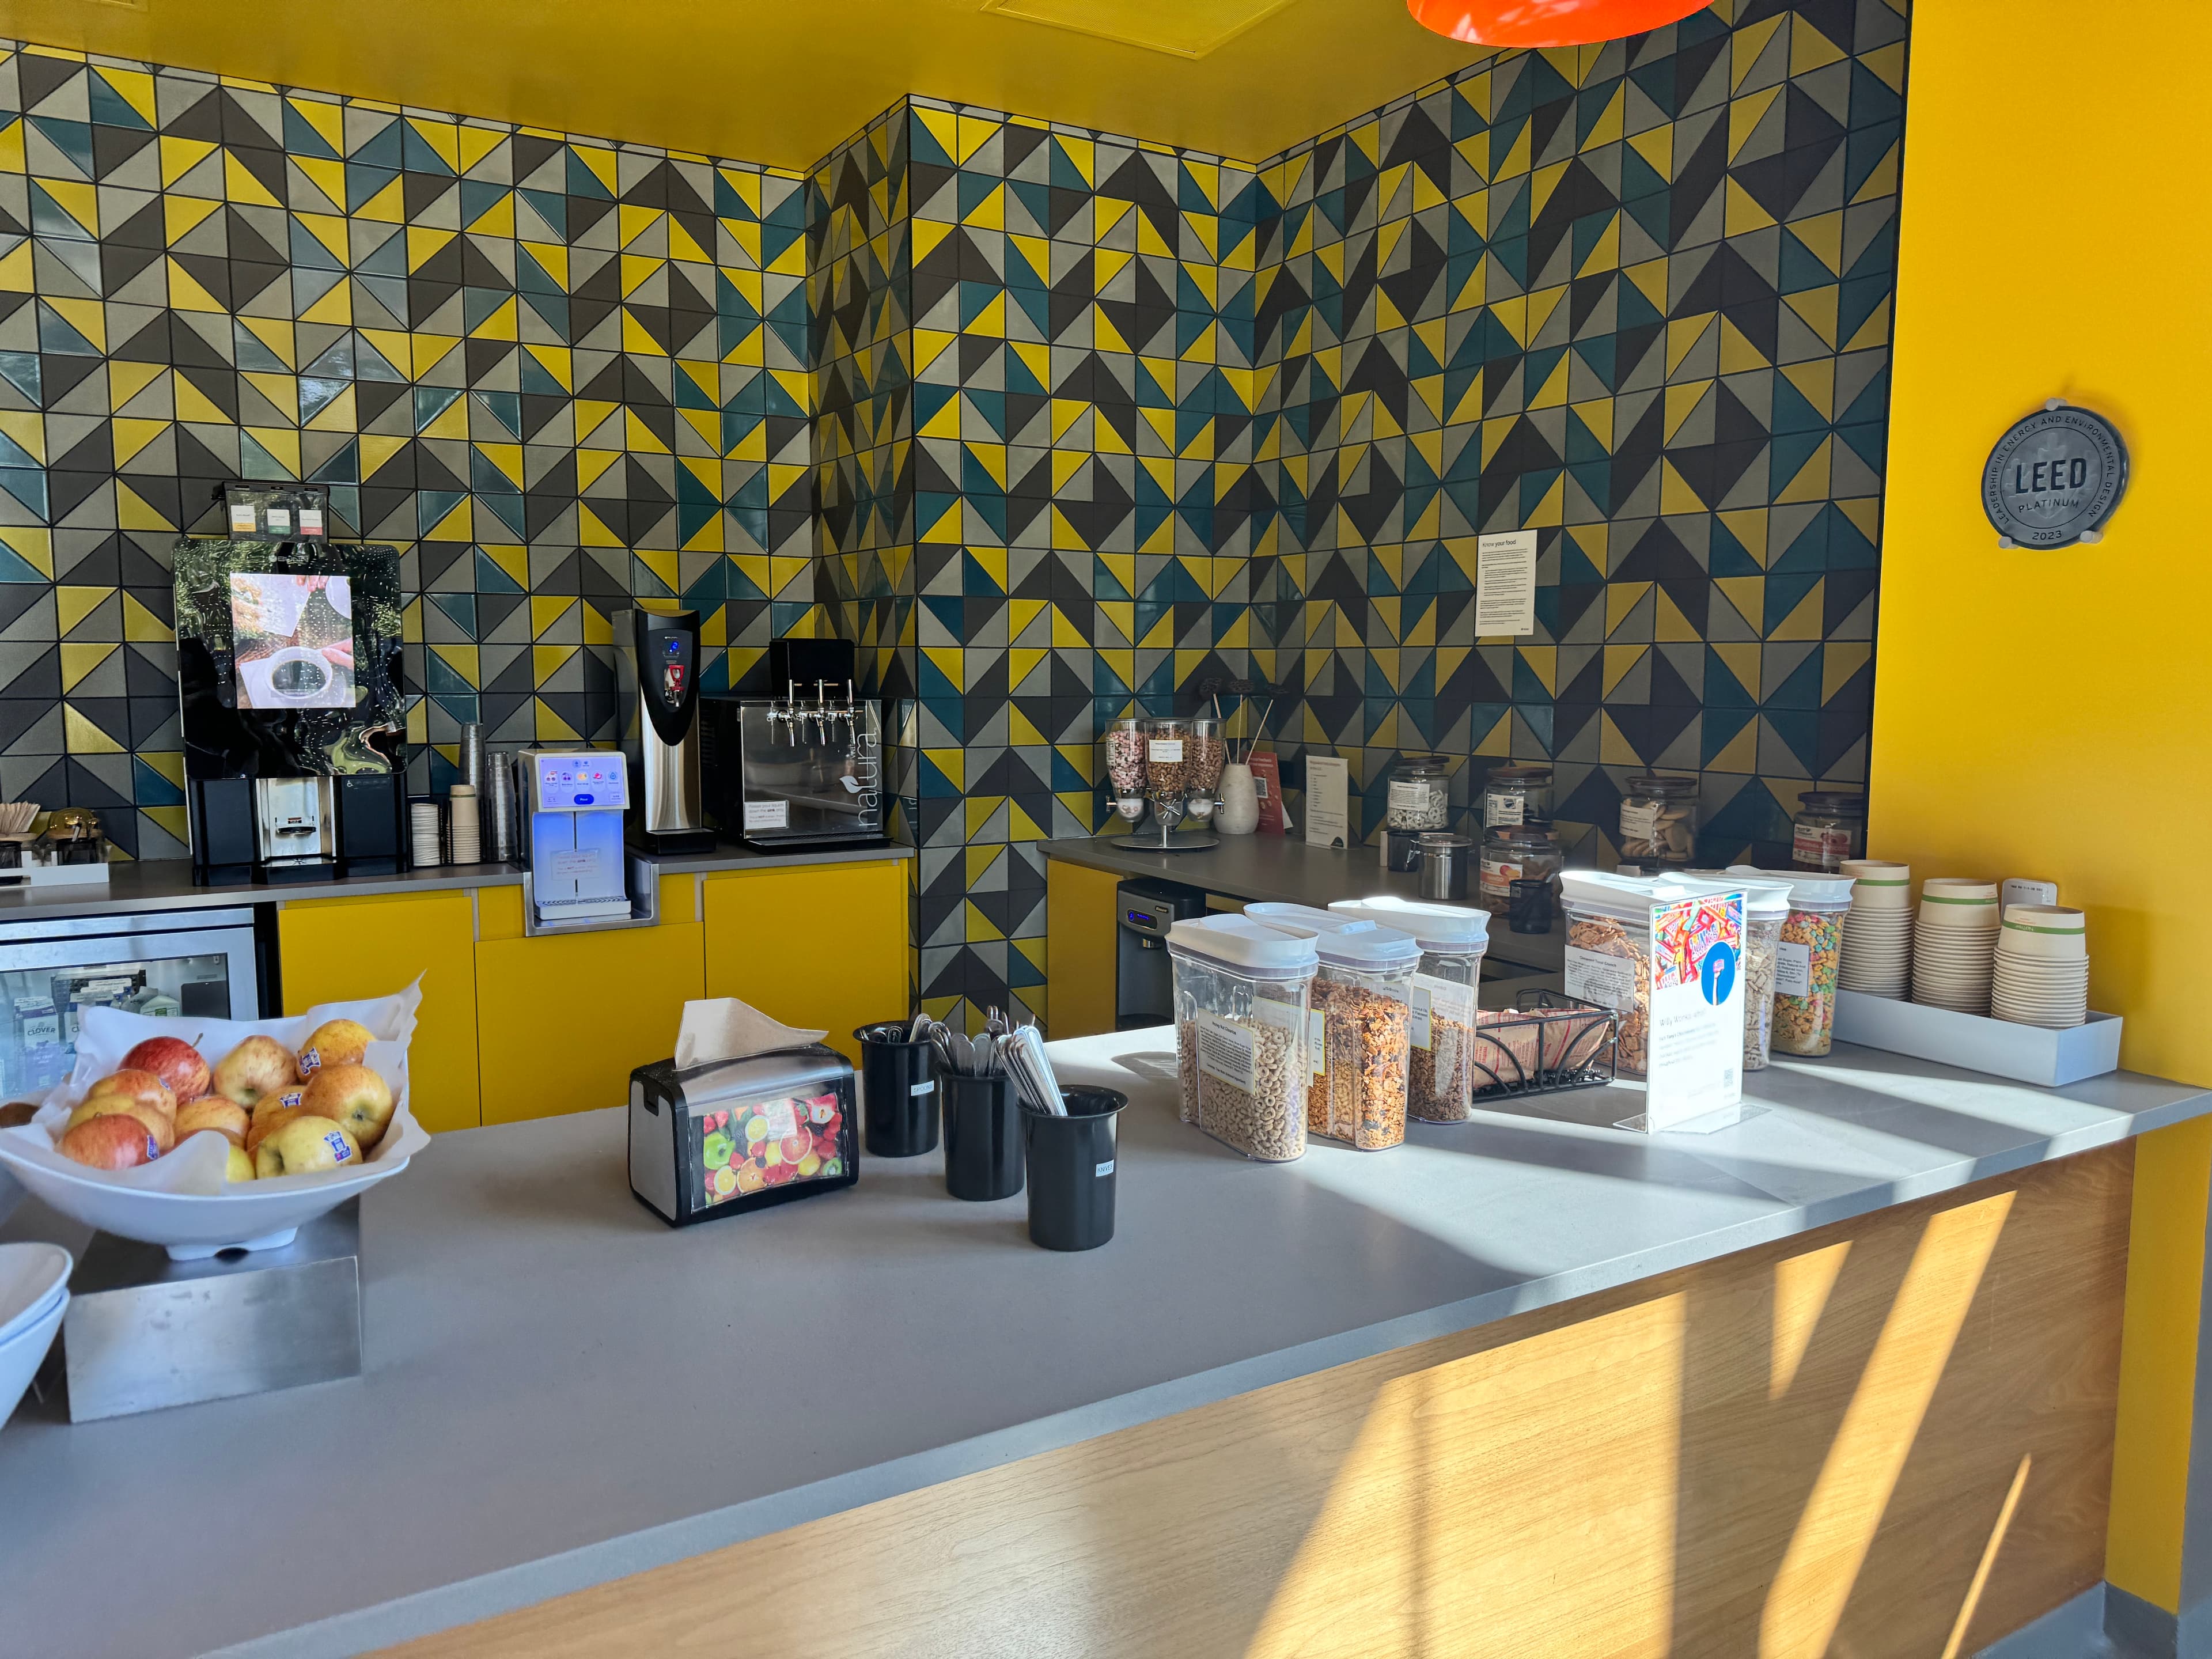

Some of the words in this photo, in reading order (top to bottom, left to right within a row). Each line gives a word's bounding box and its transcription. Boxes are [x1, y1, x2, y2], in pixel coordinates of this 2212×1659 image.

[2041, 416, 2061, 425] AND
[2003, 422, 2036, 452] ENERGY
[2065, 416, 2115, 478] ENVIRONMENTAL
[1995, 454, 2005, 464] IN
[2016, 457, 2087, 494] LEED
[1990, 467, 2009, 524] LEADERSHIP
[2018, 498, 2079, 513] PLATINUM
[2088, 482, 2112, 517] DESIGN
[2032, 530, 2062, 540] 2023
[27, 1027, 56, 1036] CLOVER
